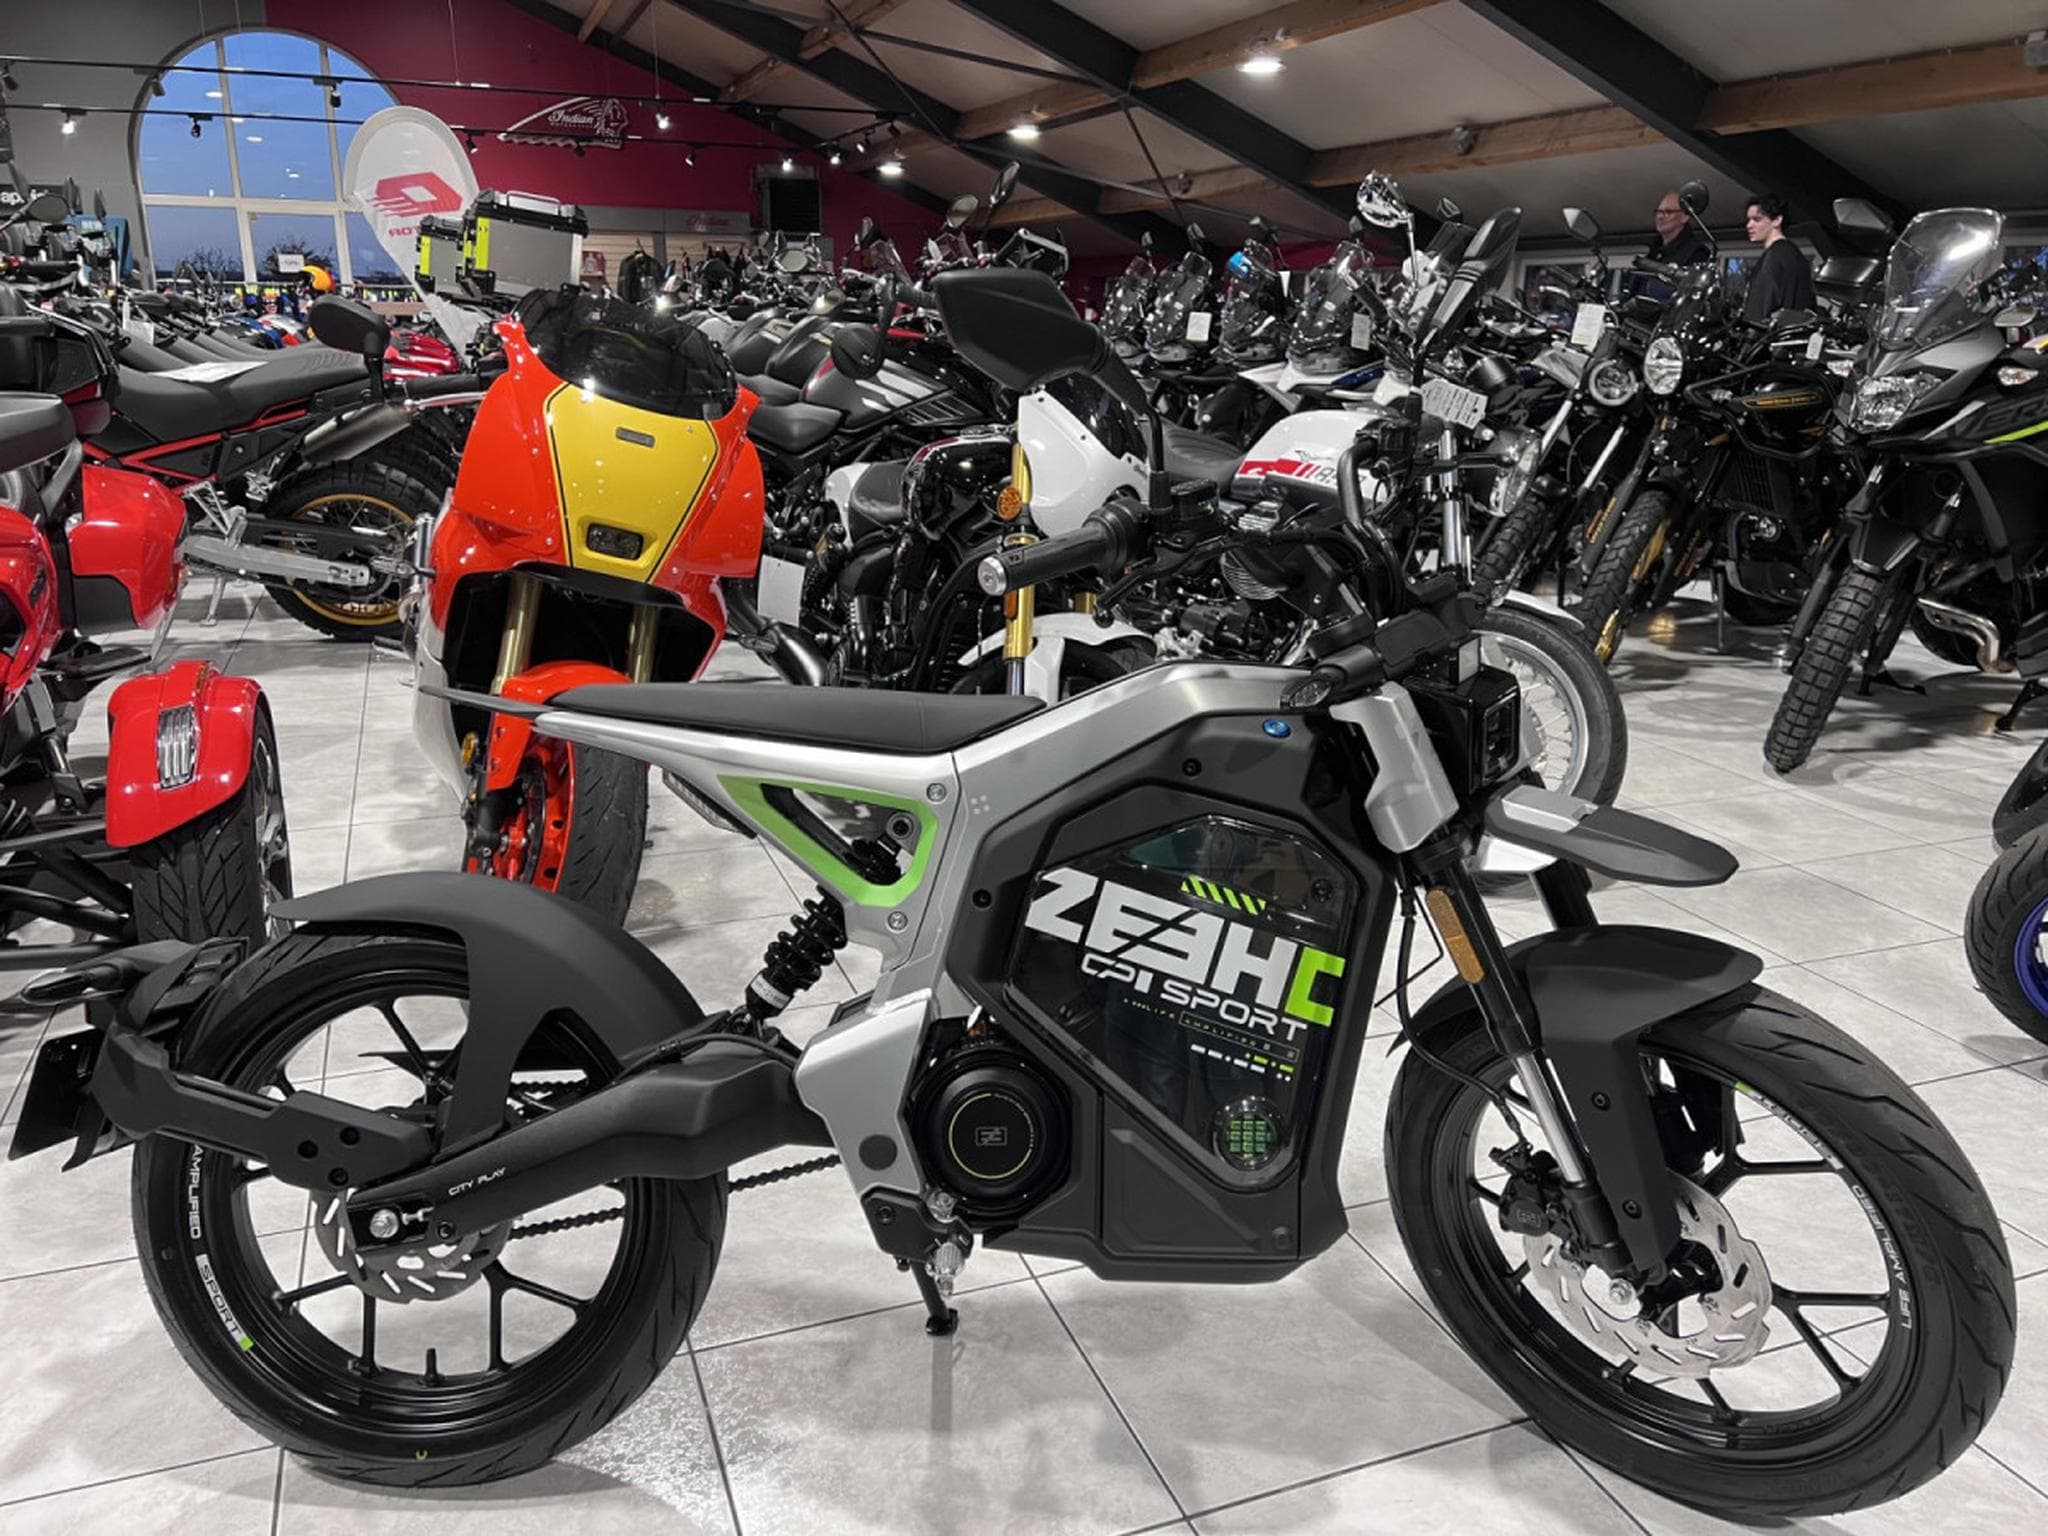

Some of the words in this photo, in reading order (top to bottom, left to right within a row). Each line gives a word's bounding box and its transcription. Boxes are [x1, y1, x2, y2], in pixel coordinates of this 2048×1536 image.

[548, 110, 594, 123] Indian
[1160, 979, 1308, 1041] SPORT
[188, 1144, 204, 1239] AMPLIFIED
[448, 1180, 474, 1196] CITY
[477, 1167, 506, 1184] PLAY
[1852, 1184, 1908, 1285] AMPLIFIED
[199, 1263, 243, 1336] SPORT
[1898, 1288, 1913, 1329] LIFE
